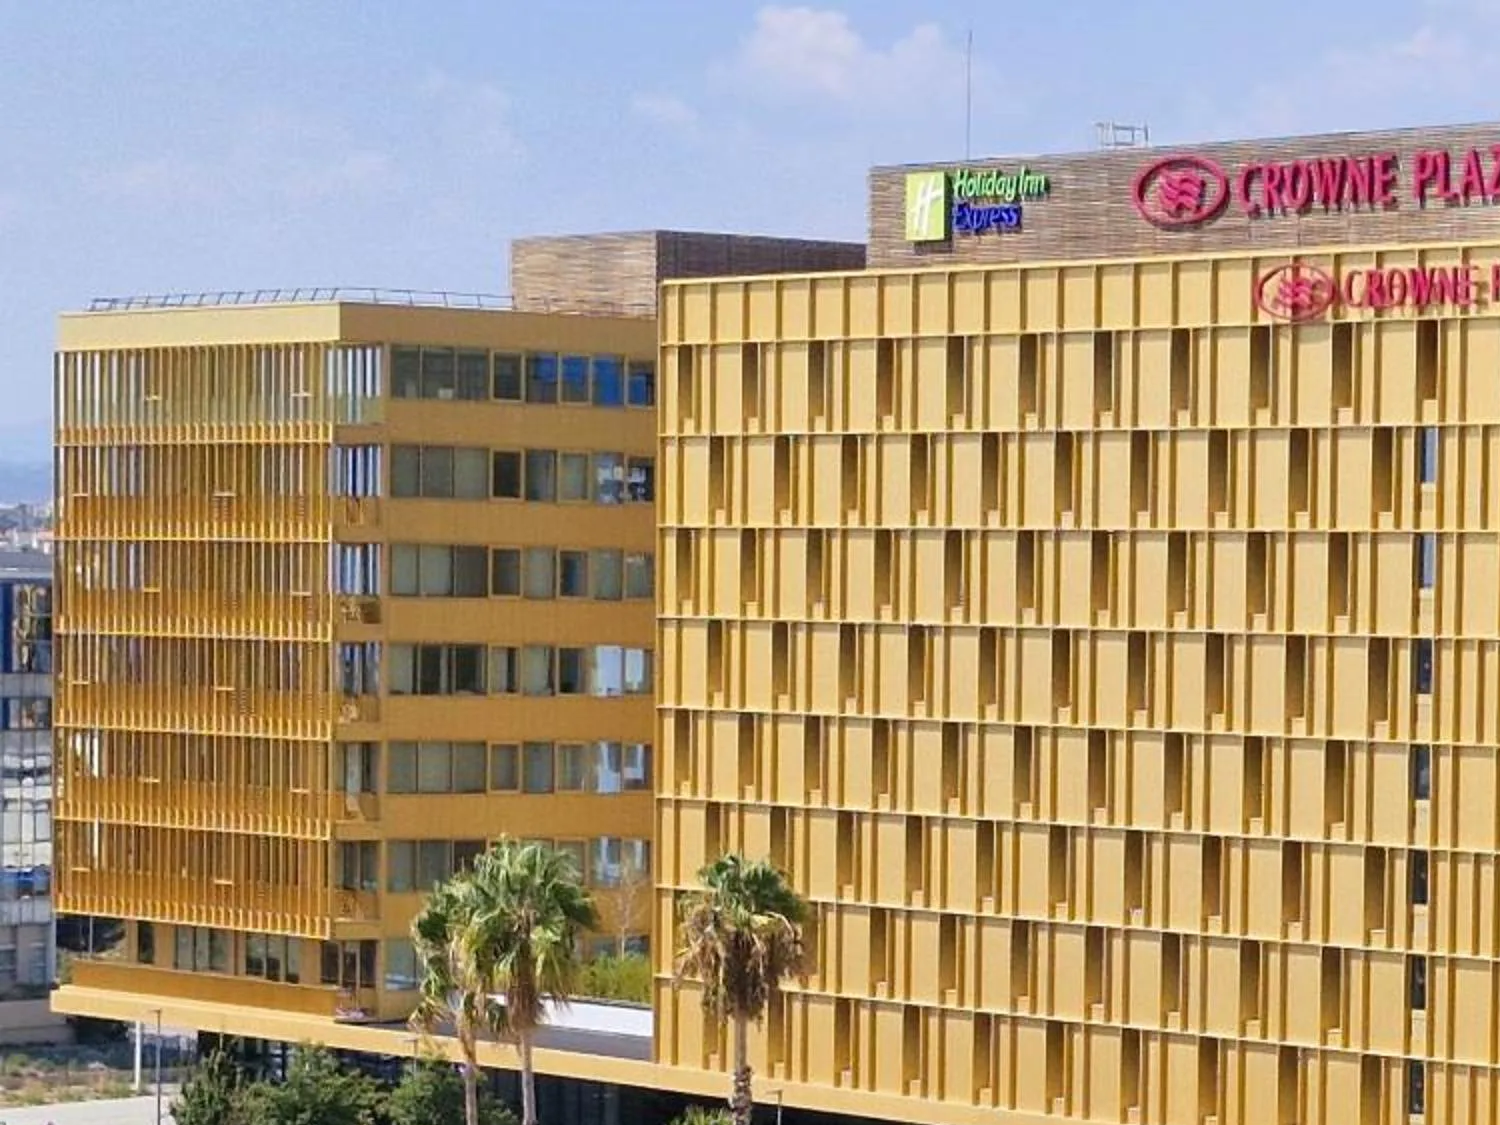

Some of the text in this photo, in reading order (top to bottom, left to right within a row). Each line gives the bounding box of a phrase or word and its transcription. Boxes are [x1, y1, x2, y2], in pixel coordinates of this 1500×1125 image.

[953, 165, 1046, 201] Holiday Inn
[1238, 153, 1398, 217] CROWNE
[953, 202, 1019, 231] Express
[1345, 264, 1479, 309] CROWNE
